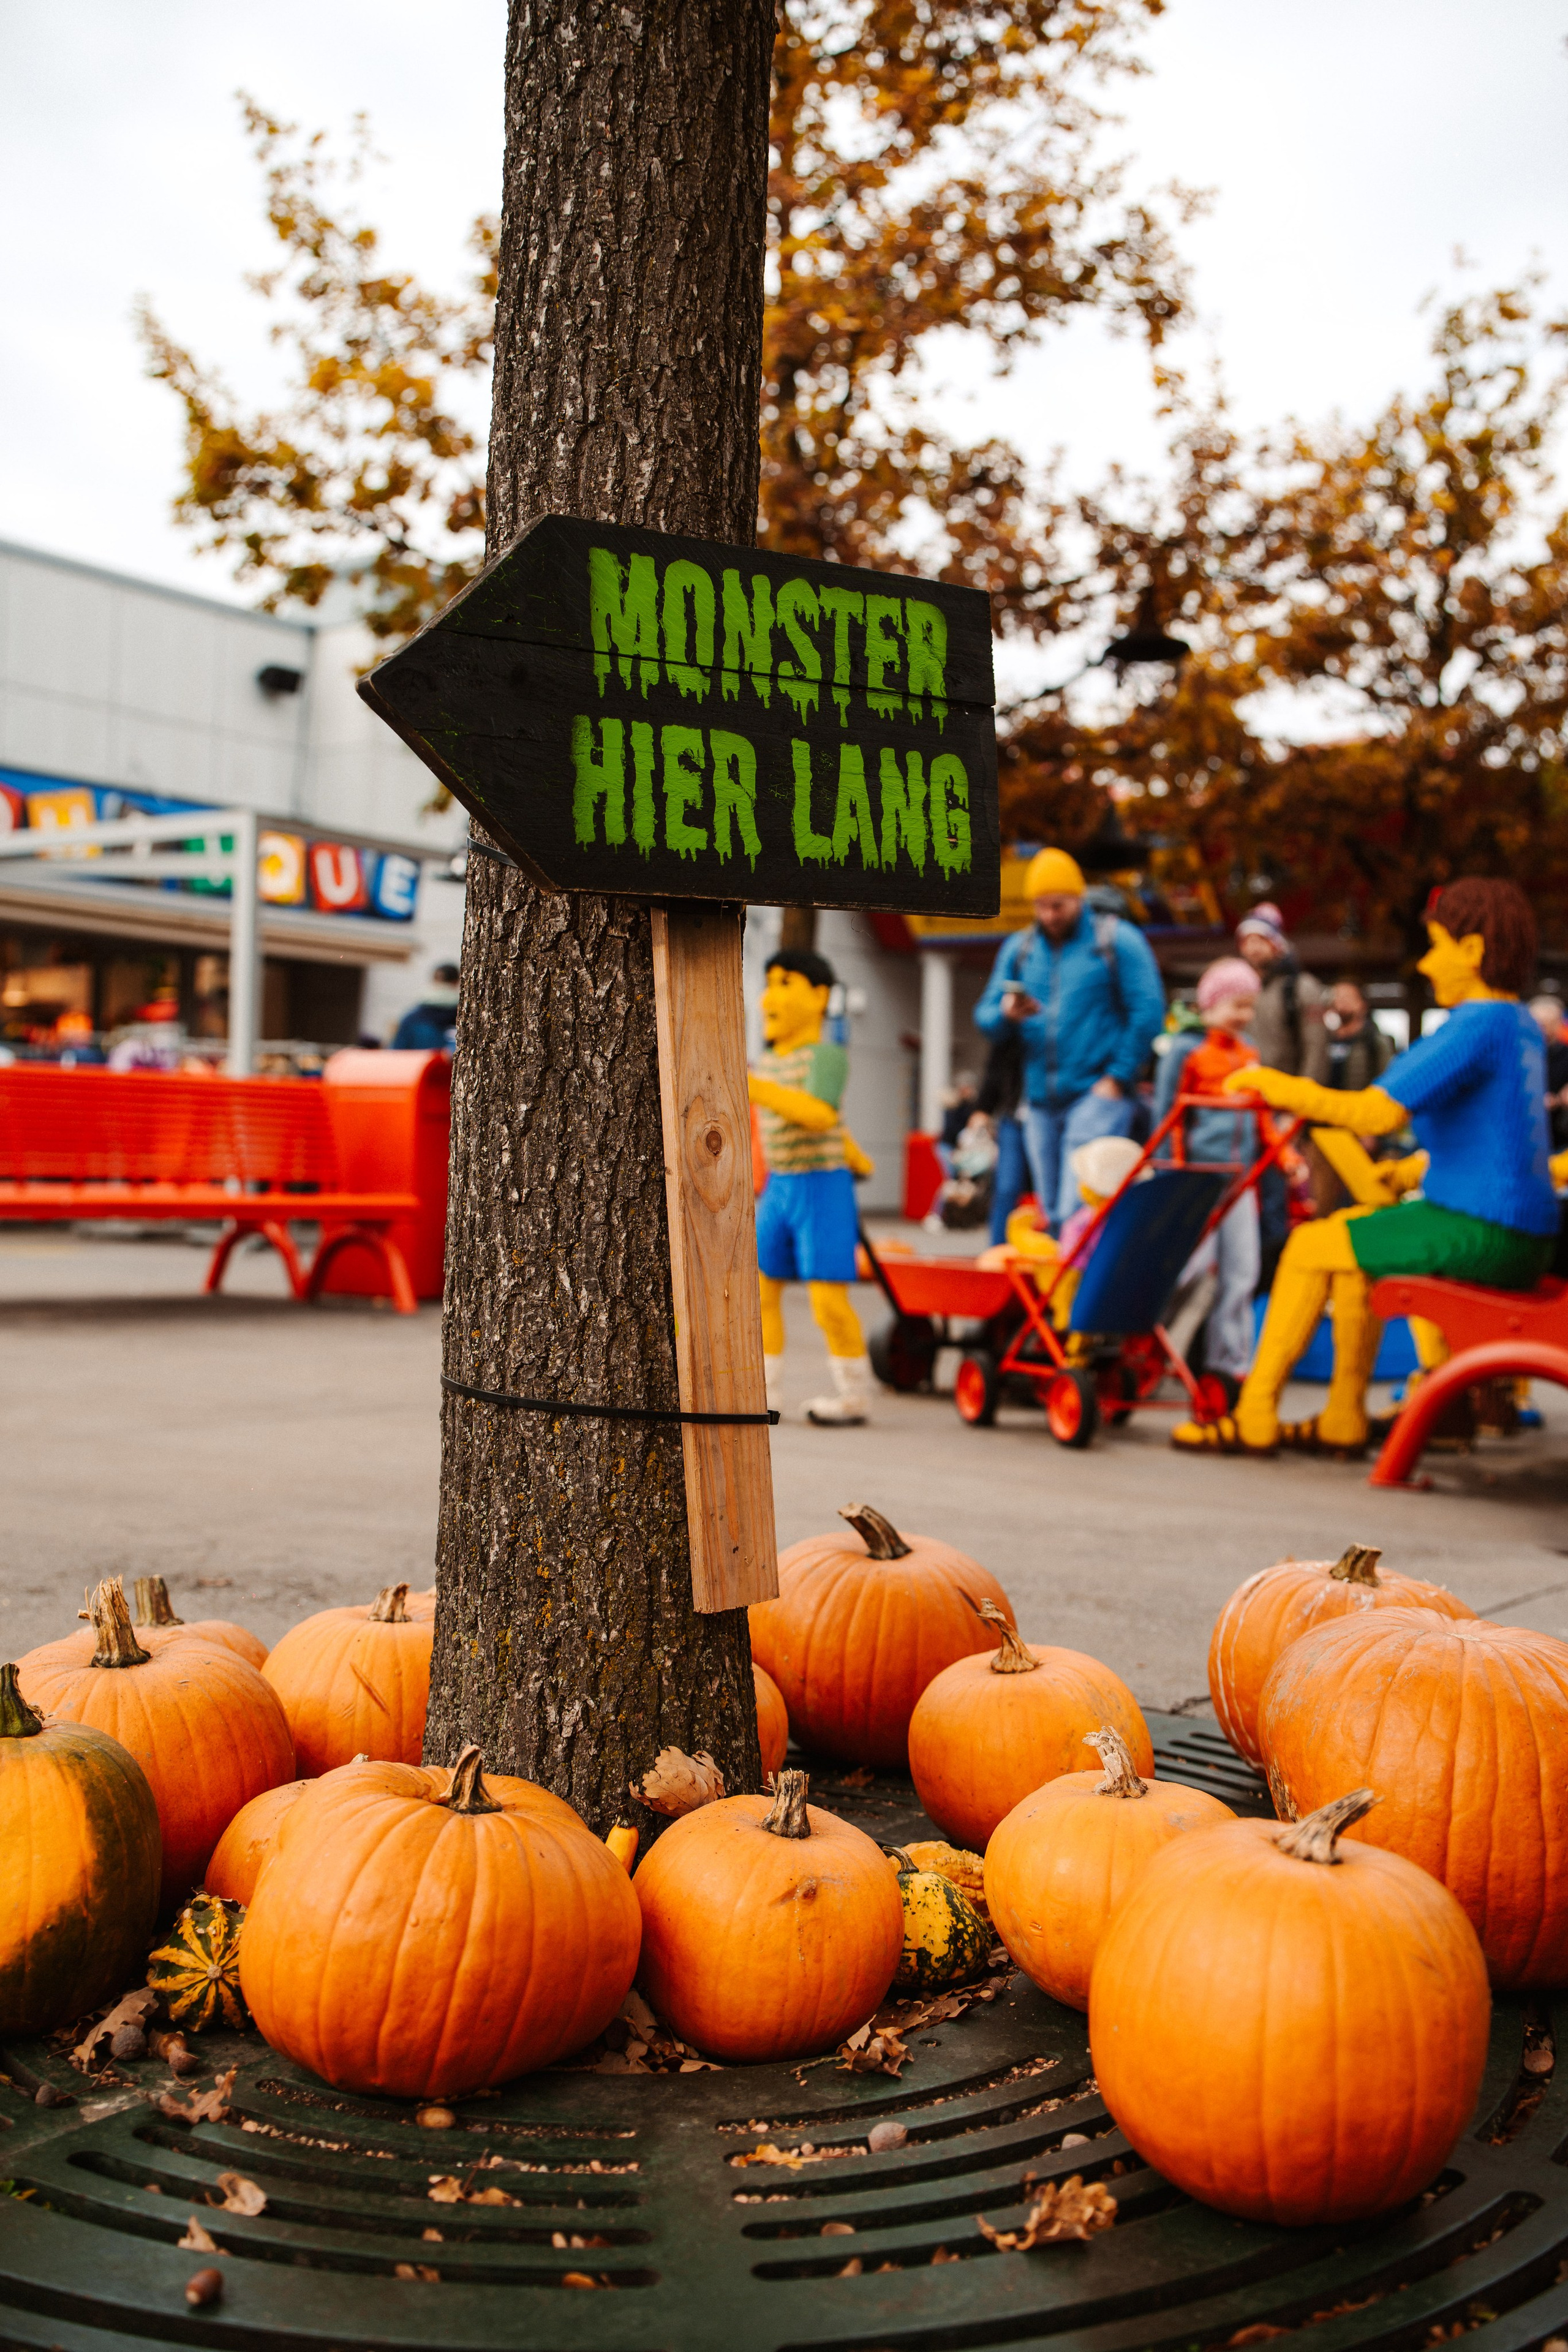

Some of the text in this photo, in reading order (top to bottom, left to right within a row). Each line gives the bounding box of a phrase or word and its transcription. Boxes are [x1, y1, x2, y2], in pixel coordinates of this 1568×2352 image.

[589, 548, 948, 734] MONSTER
[572, 715, 973, 881] HIER LANG
